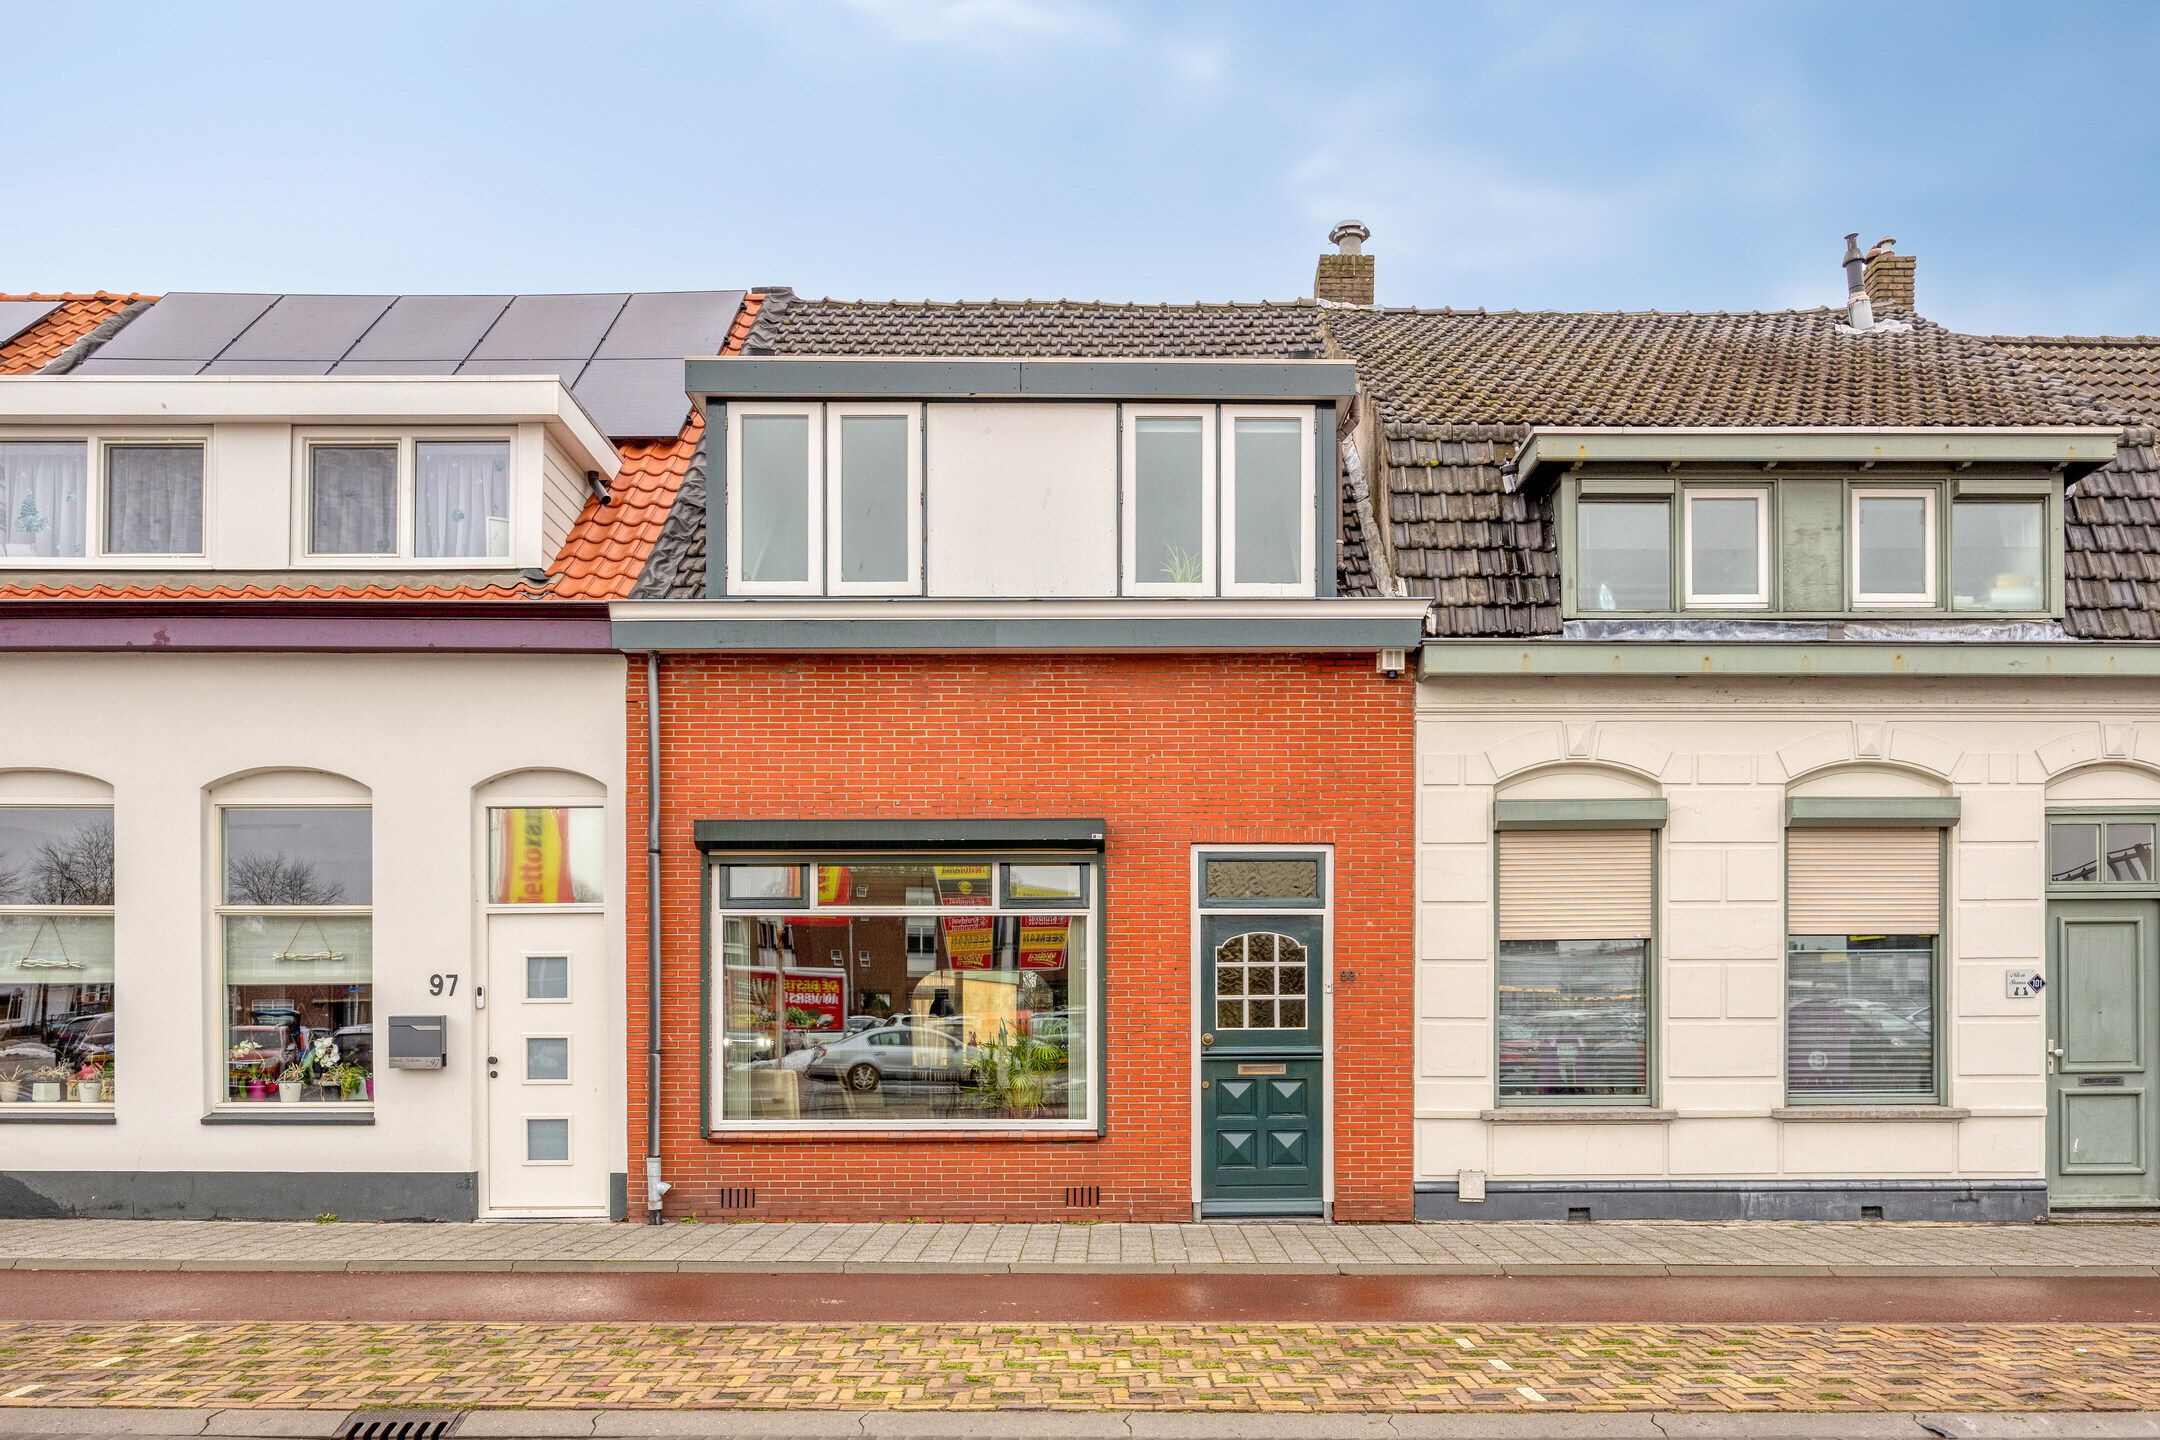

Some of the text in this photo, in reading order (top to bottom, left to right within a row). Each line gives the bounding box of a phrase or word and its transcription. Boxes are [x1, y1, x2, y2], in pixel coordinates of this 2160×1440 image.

[1340, 970, 1356, 982] 99
[429, 974, 458, 996] 97
[2032, 979, 2042, 988] 101
